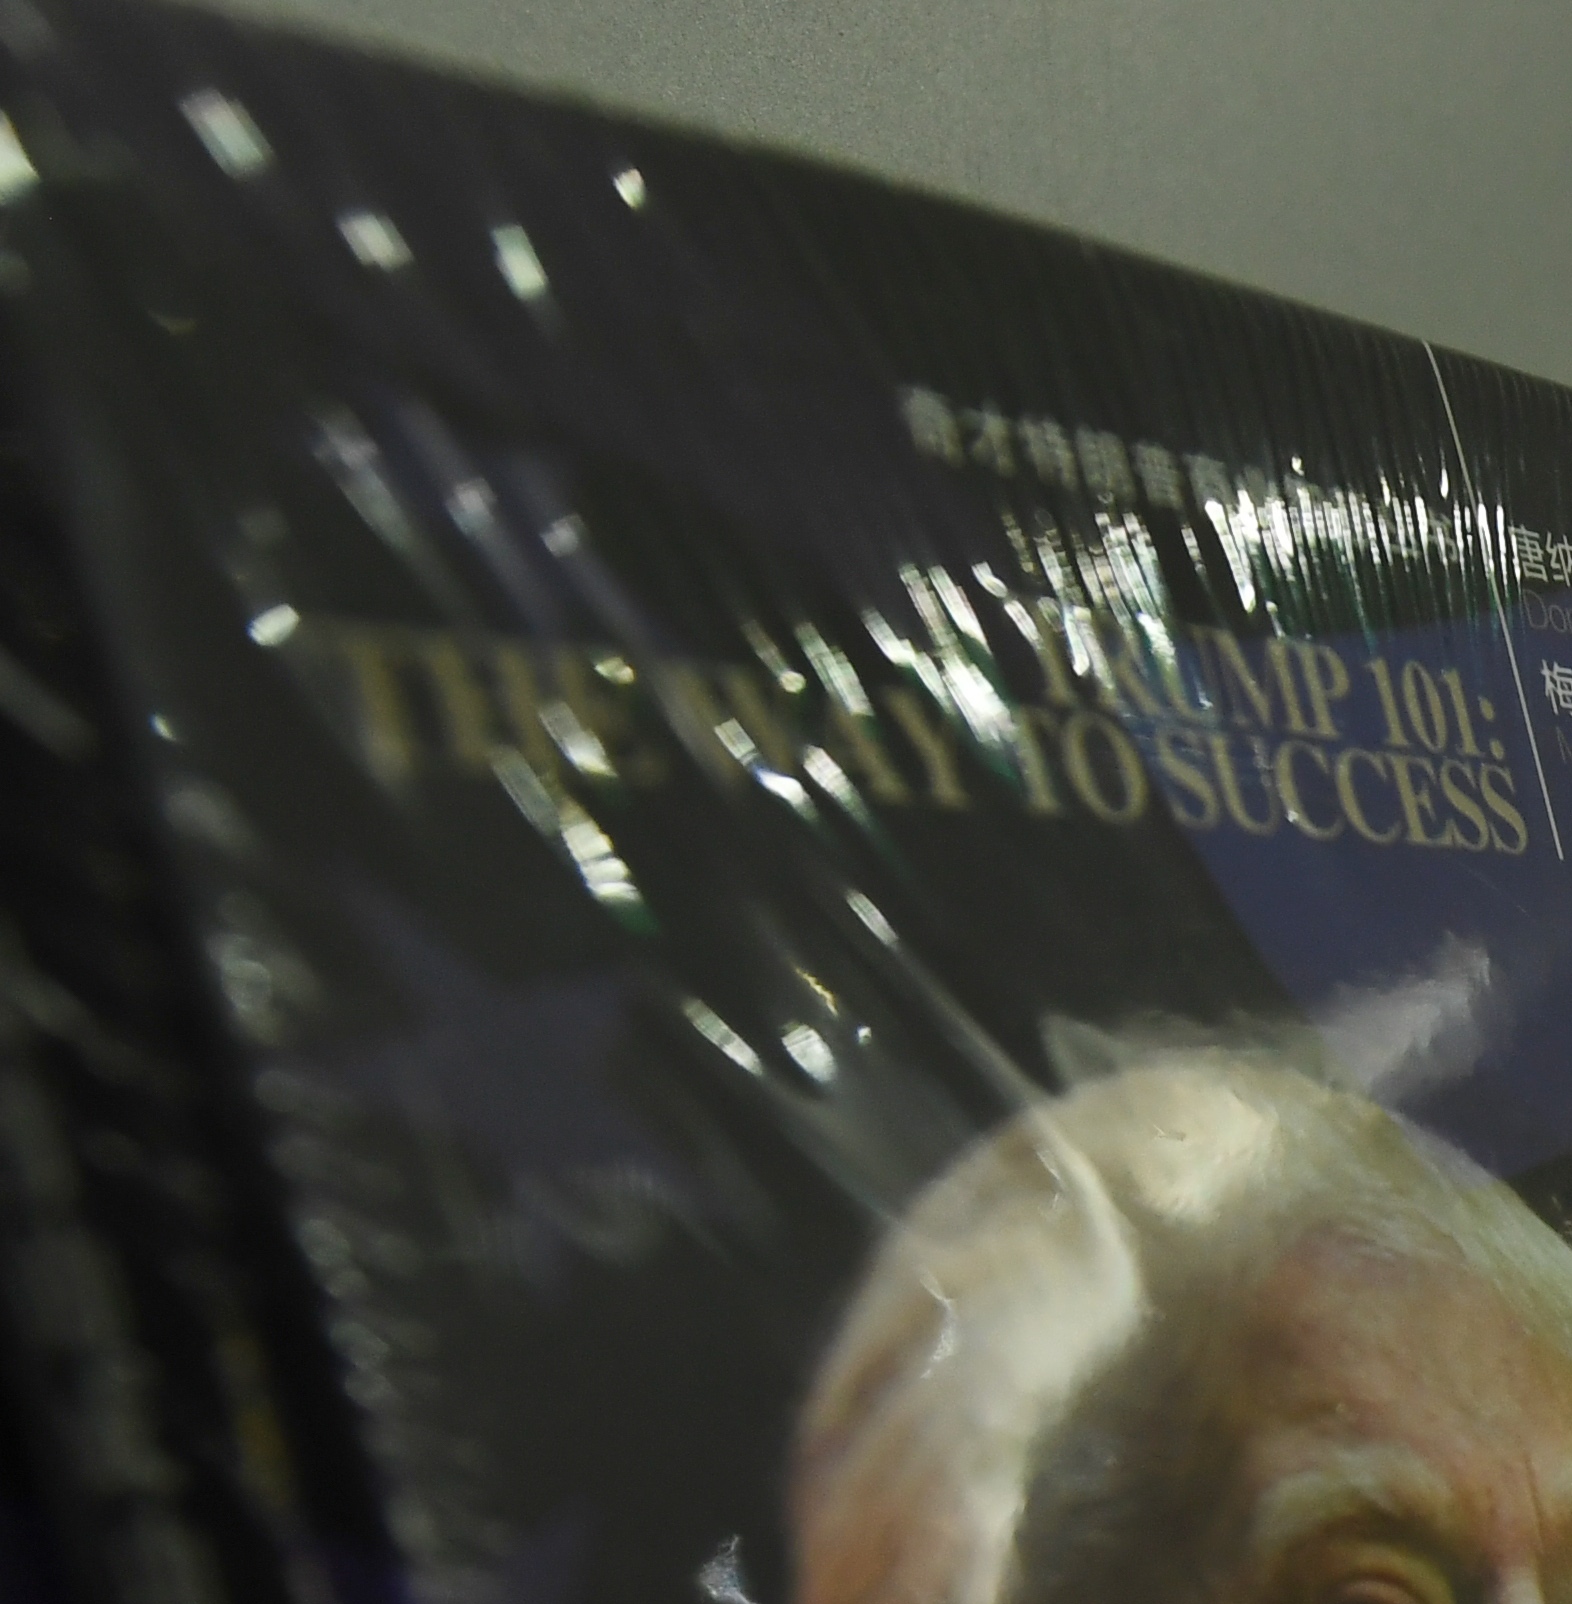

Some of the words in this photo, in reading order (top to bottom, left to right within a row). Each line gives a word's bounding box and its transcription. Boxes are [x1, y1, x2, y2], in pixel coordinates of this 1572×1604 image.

[1366, 655, 1504, 763] 101:
[1002, 702, 1149, 825] TO
[1154, 725, 1530, 857] SUCCESS
